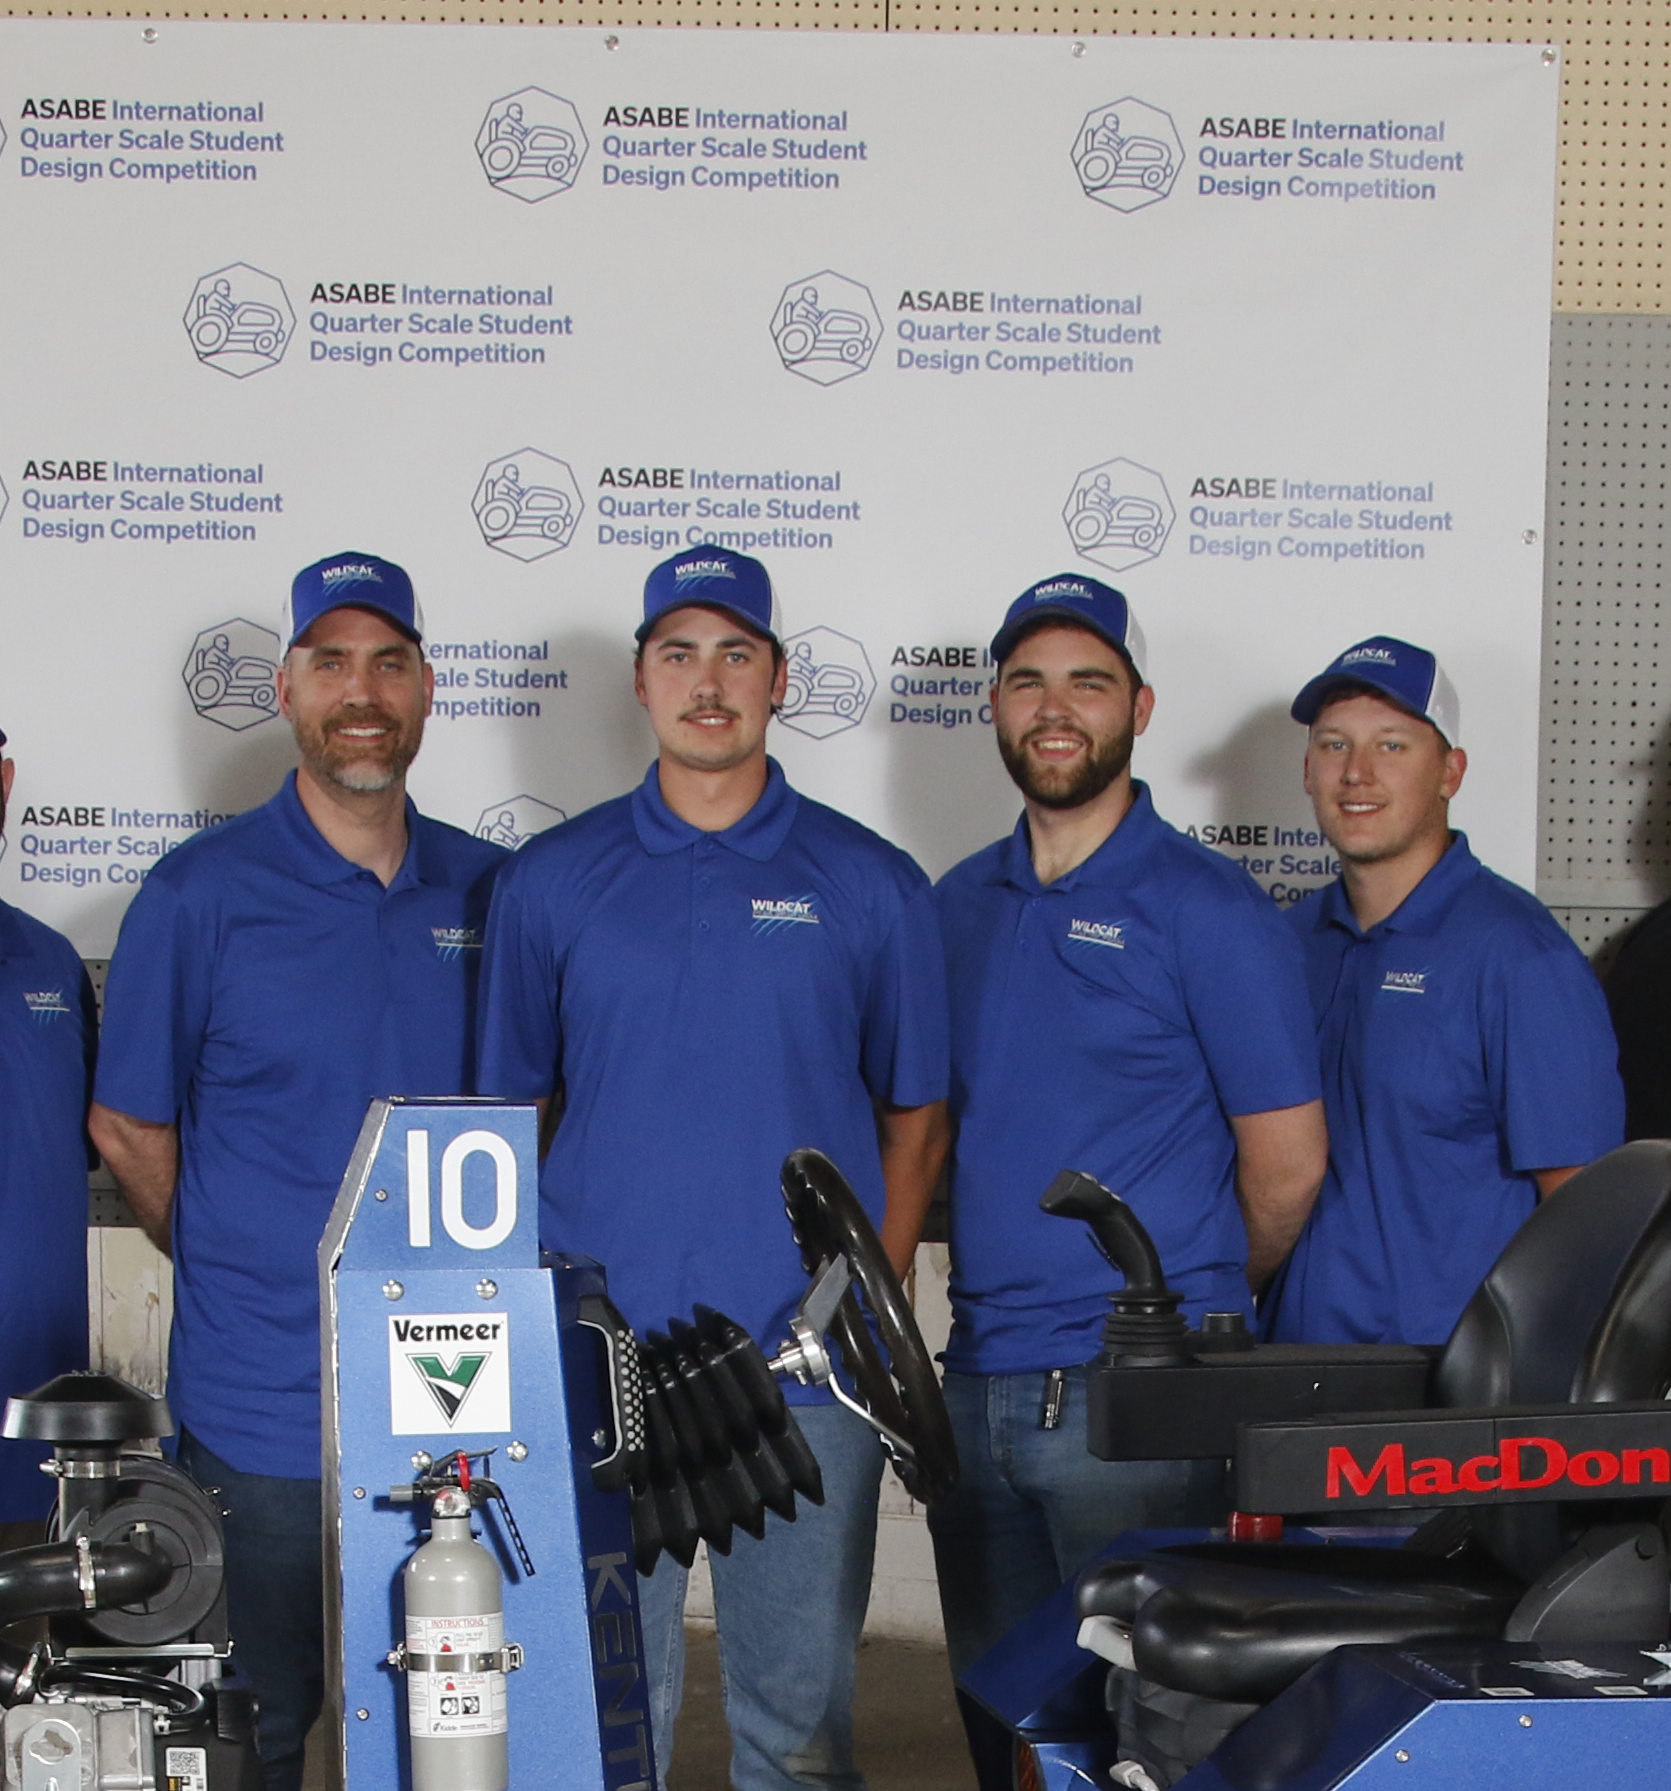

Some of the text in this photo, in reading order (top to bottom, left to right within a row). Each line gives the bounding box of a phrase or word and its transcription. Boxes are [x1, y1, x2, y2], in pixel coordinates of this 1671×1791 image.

[21, 98, 263, 122] ASABE International
[603, 106, 847, 130] ASABE International
[20, 128, 284, 151] Quarter Scale Student
[1199, 117, 1444, 140] ASABE International
[603, 135, 867, 160] Quarter Scale Student
[1199, 146, 1463, 171] Quarter Scale Student
[21, 157, 256, 183] Design Competition
[603, 165, 839, 192] Design Competition
[1199, 175, 1435, 201] Design Competition
[310, 283, 552, 305] ASABE International
[898, 290, 1141, 314] ASABE International
[310, 312, 572, 335] Quarter Scale Student
[898, 320, 1160, 344] Quarter Scale Student
[311, 341, 544, 367] Design Competition
[898, 349, 1132, 375] Design Competition
[22, 460, 262, 483] ASABE International
[598, 467, 840, 491] ASABE International
[23, 489, 282, 512] Quarter Scale Student
[1190, 478, 1432, 501] ASABE International
[598, 496, 860, 520] Quarter Scale Student
[1190, 506, 1451, 530] Quarter Scale Student
[24, 518, 255, 544] Design Competition
[598, 525, 833, 549] Design Competition
[1190, 535, 1423, 561] Design Competition
[475, 668, 567, 688] Student
[751, 899, 811, 914] WILDCAT
[1071, 919, 1122, 939] WILDCAT
[407, 1129, 517, 1250] 10
[393, 1320, 501, 1342] Vermeer
[1327, 1436, 1670, 1498] MacDon
[431, 1617, 484, 1628] INSTRUCTIONS
